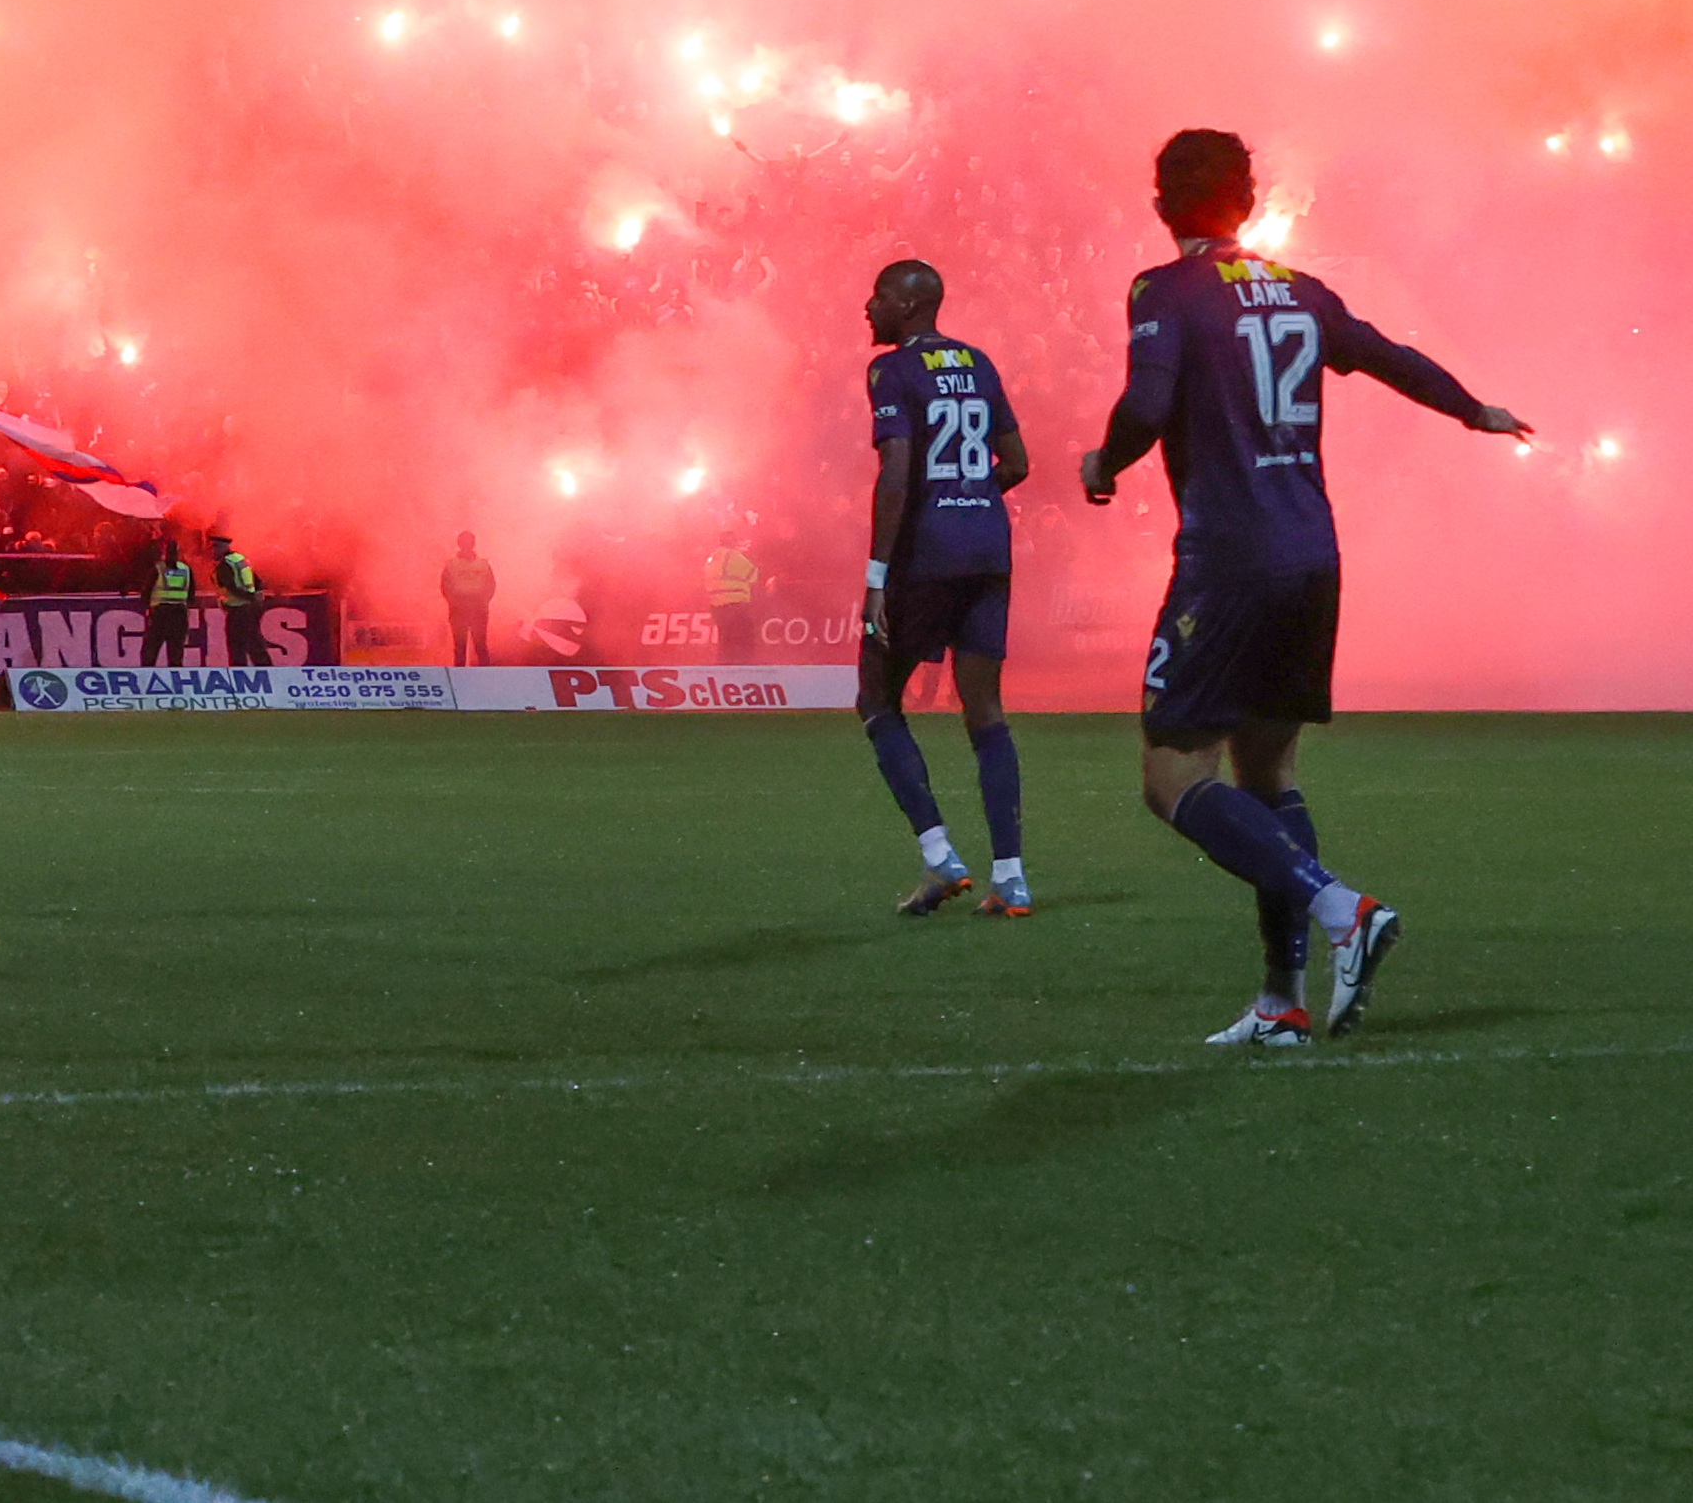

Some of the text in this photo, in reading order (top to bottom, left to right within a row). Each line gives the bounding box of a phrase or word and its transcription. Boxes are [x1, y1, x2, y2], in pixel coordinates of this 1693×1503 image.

[1216, 259, 1294, 283] MKM
[921, 348, 975, 371] MKM
[1235, 312, 1320, 427] 12
[935, 373, 977, 395] SYLLA
[926, 398, 991, 481] 28
[1144, 636, 1171, 690] 2
[74, 669, 274, 696] GRAHAM
[301, 668, 422, 684] Telephone
[287, 684, 445, 698] 01250 875 555
[83, 695, 275, 711] PEST CONTROL
